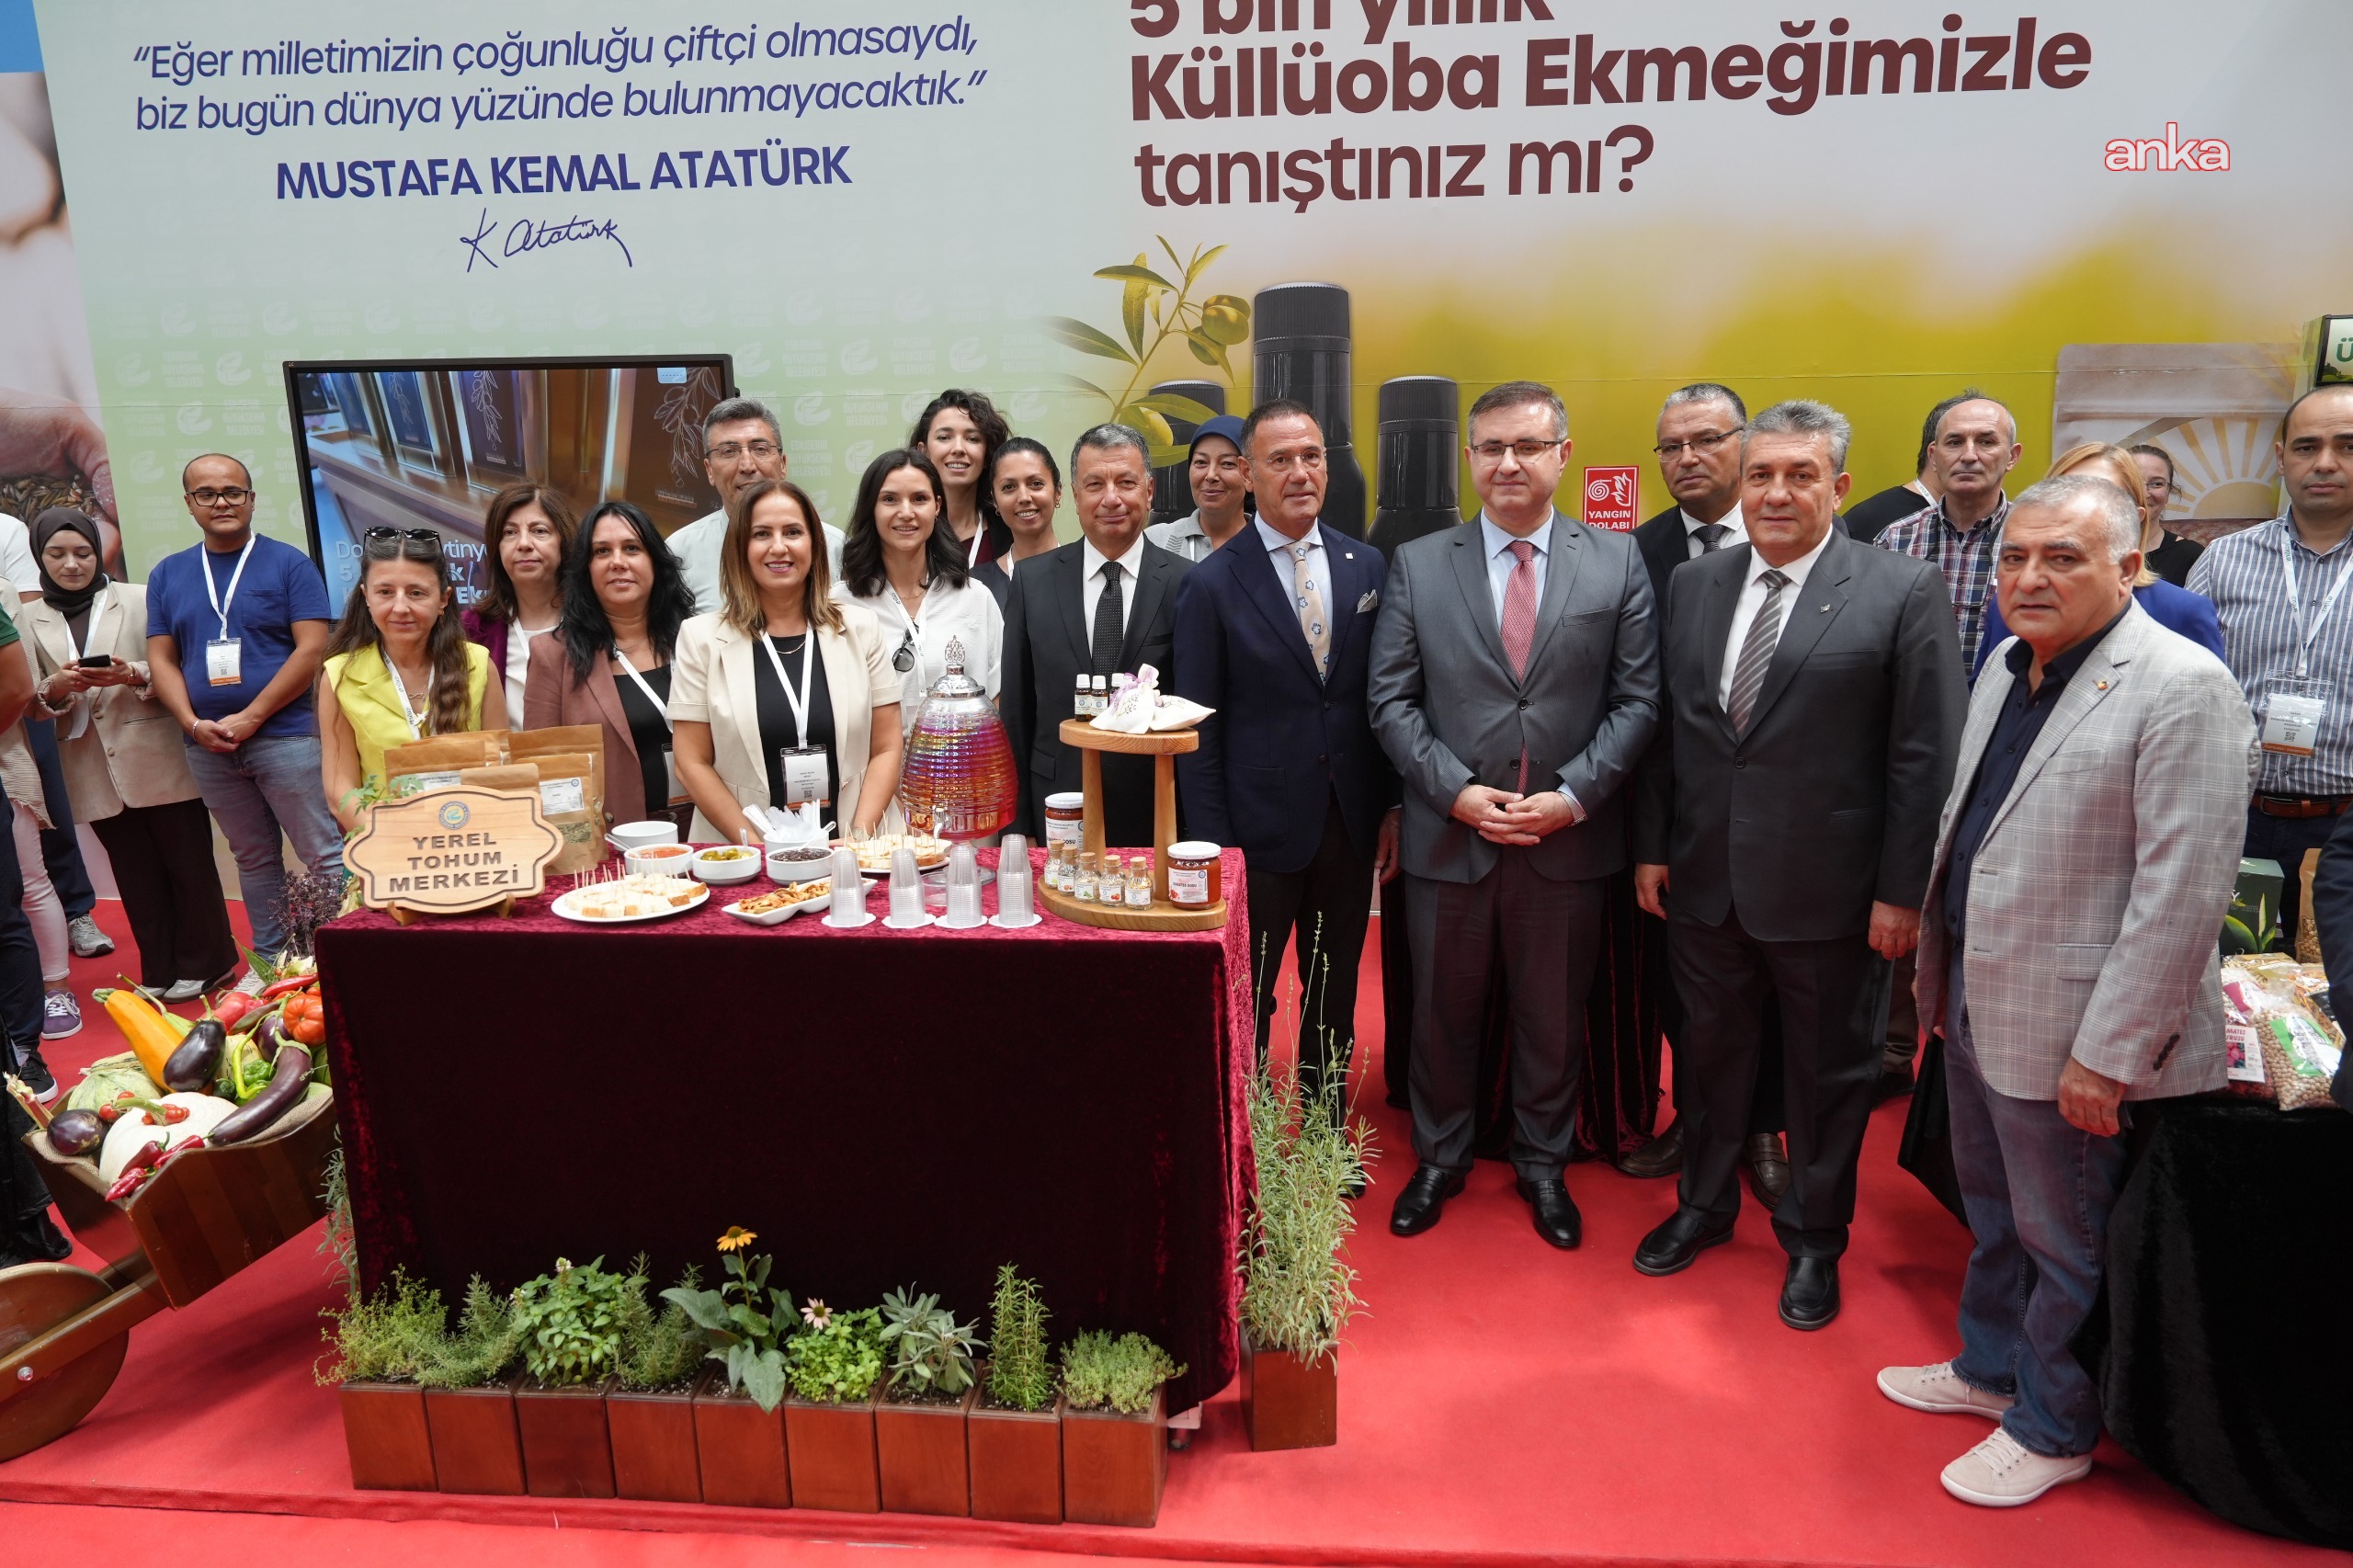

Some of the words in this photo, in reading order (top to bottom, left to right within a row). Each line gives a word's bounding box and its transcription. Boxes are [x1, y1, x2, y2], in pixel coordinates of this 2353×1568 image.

[1131, 0, 1179, 39] 5
[242, 40, 444, 76] milletimizin
[452, 31, 654, 77] çoğunluğu
[664, 24, 757, 68] çiftçi
[766, 16, 978, 58] olmasaydı,
[1131, 41, 1500, 121] Küllüoba
[1525, 14, 2092, 117] Ekmeğimizle
[136, 95, 188, 131] biz
[198, 93, 314, 134] bugün
[324, 91, 441, 131] dünya
[450, 84, 614, 131] yüzünde
[277, 158, 483, 199] MUSTAFA
[490, 153, 642, 195] KEMAL
[649, 138, 854, 190] ATATÜRK
[1133, 137, 1486, 214] tanıştınız
[1508, 125, 1654, 196] mı?
[1588, 510, 1631, 519] YANGIN
[1588, 521, 1630, 529] DOLABI
[407, 851, 502, 870] TOHUM
[413, 832, 497, 850] YEREL
[389, 864, 519, 892] MERKEZİ
